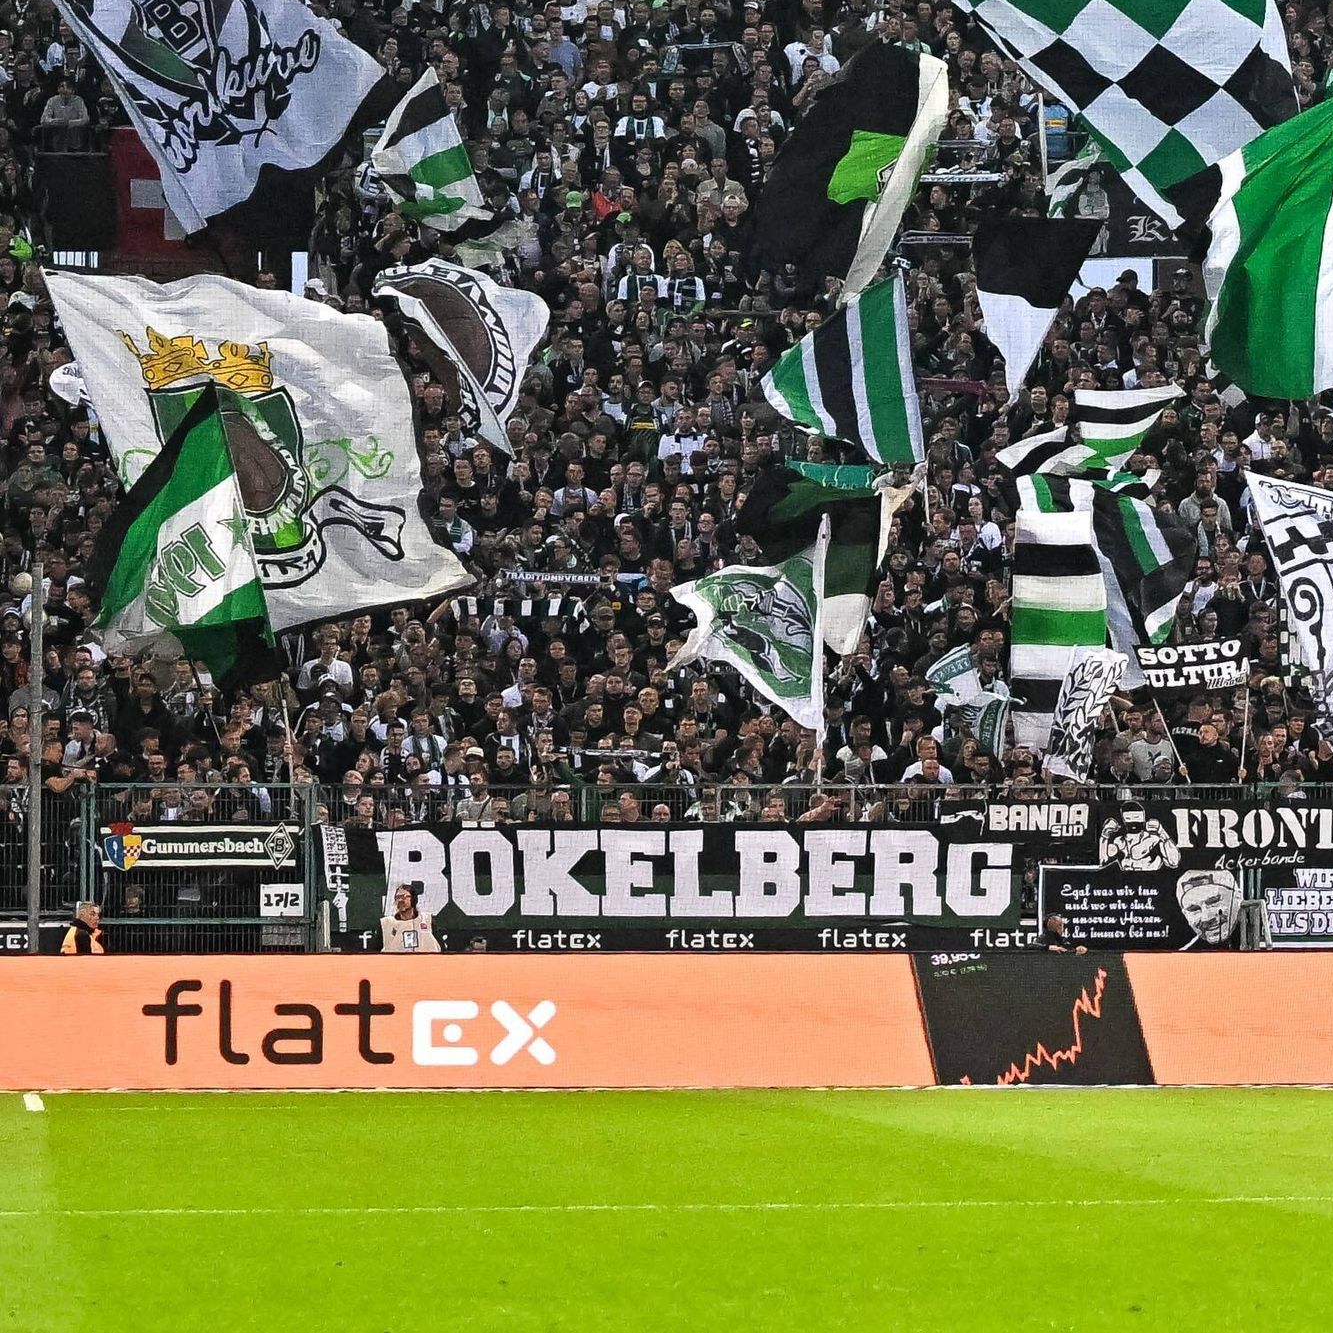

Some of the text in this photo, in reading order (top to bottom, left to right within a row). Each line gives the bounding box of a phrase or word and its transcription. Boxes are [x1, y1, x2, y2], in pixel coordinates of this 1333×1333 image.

[1137, 639, 1241, 665] SOTTO
[989, 803, 1090, 832] BANDA
[1051, 823, 1084, 838] SUD
[142, 836, 264, 855] Gummersbach
[1215, 849, 1305, 870] Ackerbande
[380, 829, 1012, 917] BOKELBERG
[263, 891, 300, 908] 17/2
[1061, 884, 1091, 900] Egal
[1117, 885, 1135, 897] wir
[1065, 899, 1089, 911] und
[1110, 900, 1128, 911] wir
[1072, 916, 1116, 925] unseren
[1267, 912, 1311, 935] ALS
